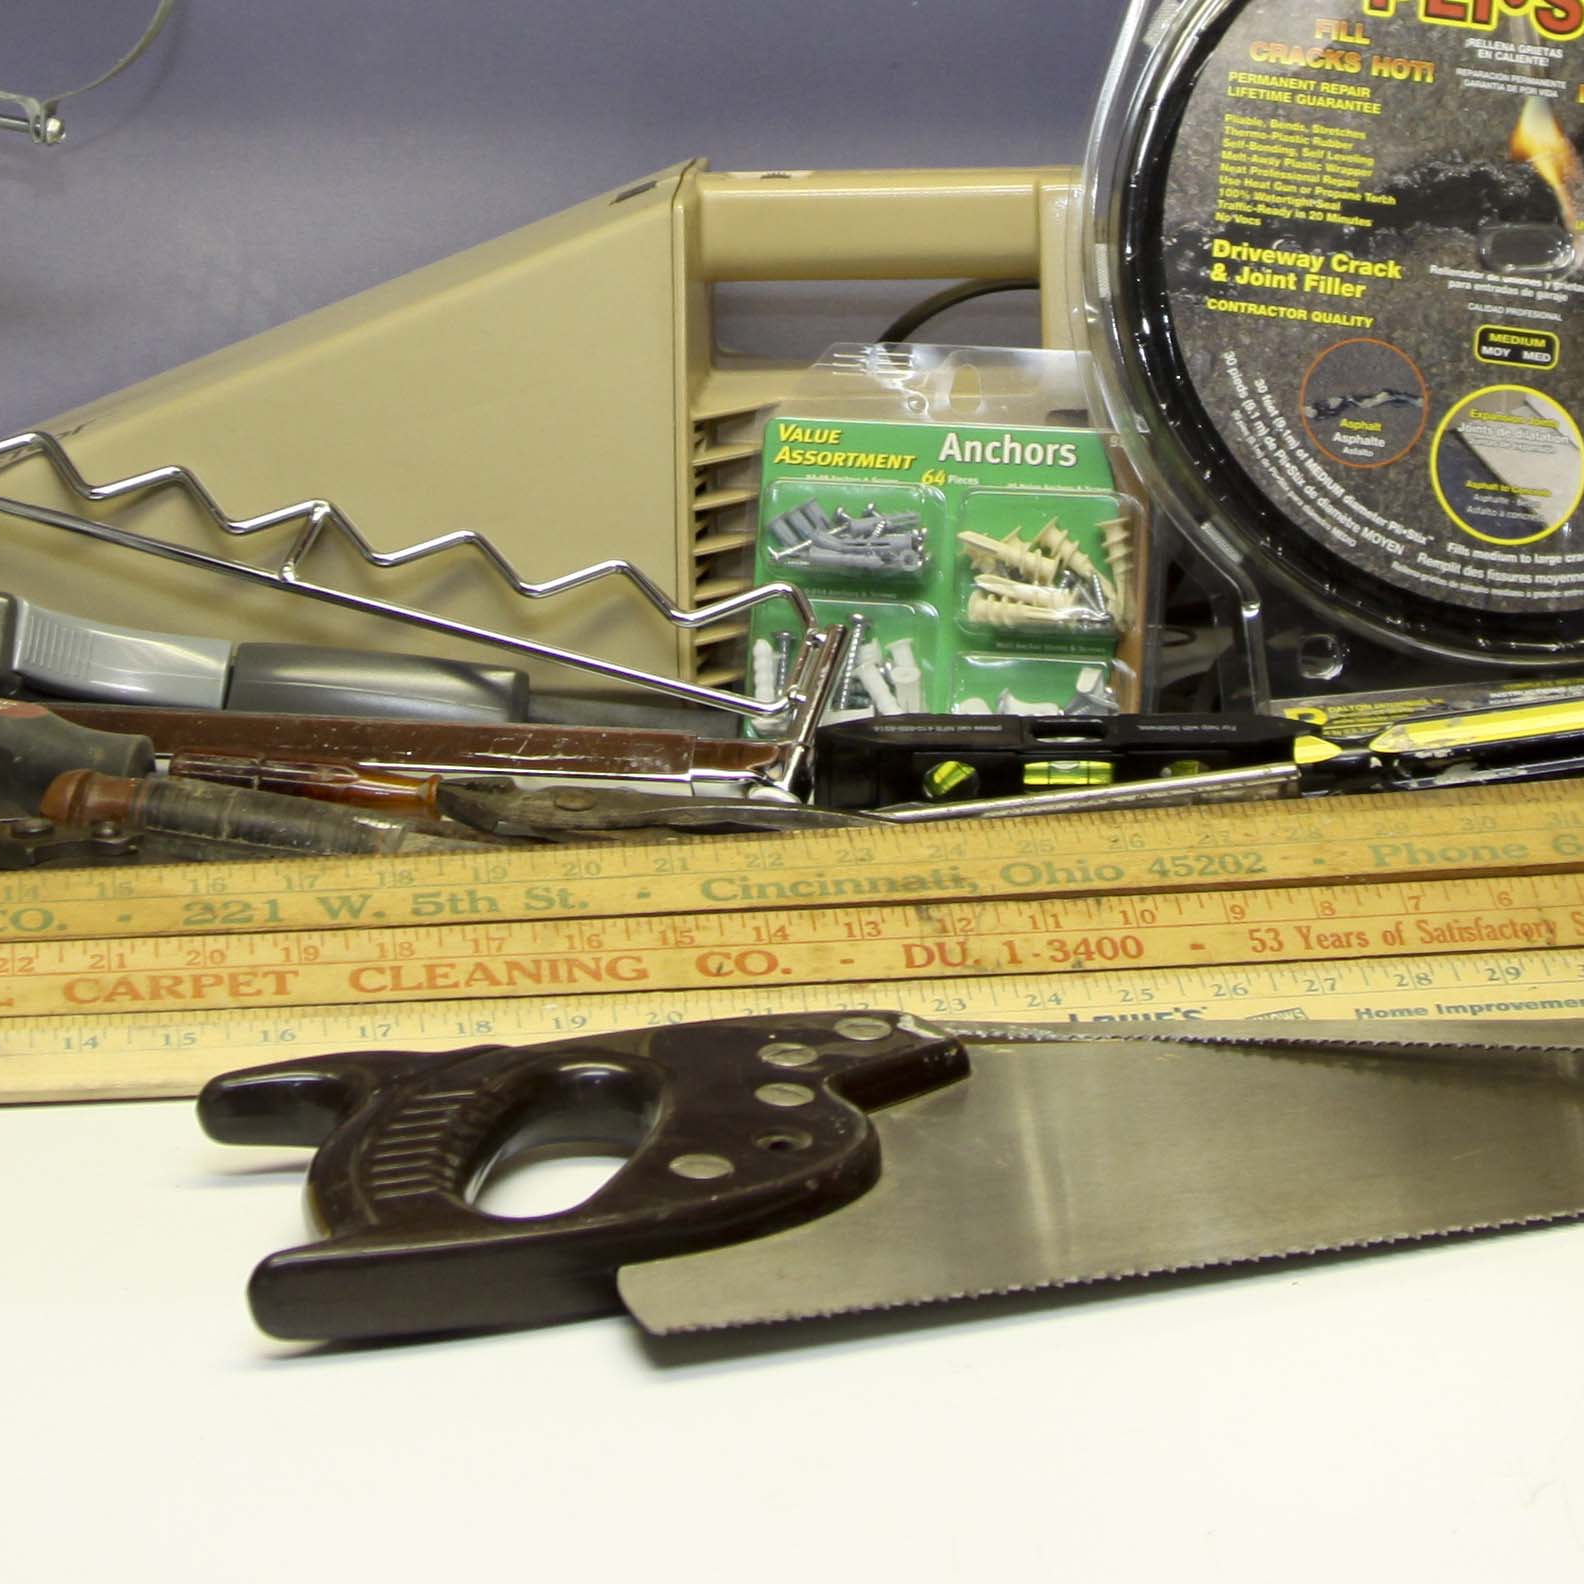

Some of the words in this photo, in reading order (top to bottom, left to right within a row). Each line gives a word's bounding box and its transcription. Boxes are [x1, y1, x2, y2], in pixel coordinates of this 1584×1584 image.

[1315, 19, 1371, 46] FILL
[1249, 41, 1362, 73] CRACKS
[1371, 55, 1436, 84] HOT!
[1228, 71, 1316, 91] PERMANENT
[1320, 83, 1371, 98] REPAIR
[1227, 86, 1293, 103] LIFETIME
[1296, 94, 1382, 114] GUARANTEE
[1212, 238, 1326, 272] Driveway
[1330, 253, 1402, 279] Crack
[1209, 263, 1228, 282] &
[1235, 267, 1298, 290] Joint
[1303, 273, 1366, 298] Filler
[1206, 298, 1307, 321] CONTRACTOR
[1311, 310, 1374, 329] QUALITY
[1481, 344, 1511, 357] MOY
[1522, 351, 1552, 362] MED
[1489, 332, 1546, 347] MEDIUM
[777, 423, 841, 445] VALUE
[1339, 418, 1382, 432] Asphalt
[938, 432, 1078, 468] Anchors
[1332, 432, 1386, 448] Asphalte
[774, 446, 917, 470] ASSORTMENT
[921, 470, 946, 486] 64
[947, 474, 979, 486] Pieces
[180, 897, 283, 928] 221
[318, 891, 389, 922] W.
[410, 886, 500, 919] 5th
[523, 883, 590, 913] St.
[699, 862, 981, 903] Cincinnati,
[998, 855, 1125, 886] Ohio
[1147, 850, 1268, 881] 45202
[1368, 835, 1531, 870] Phone
[61, 968, 300, 1008] CARPET
[348, 954, 649, 992] CLEANING
[693, 948, 793, 979] CO.
[901, 942, 986, 972] DU.
[1005, 934, 1146, 966] 1-3400
[1249, 926, 1286, 955] 53
[1294, 923, 1370, 950] Years
[1380, 920, 1406, 946] of
[1413, 913, 1558, 952] Satisfactory
[1353, 1005, 1432, 1022] Home
